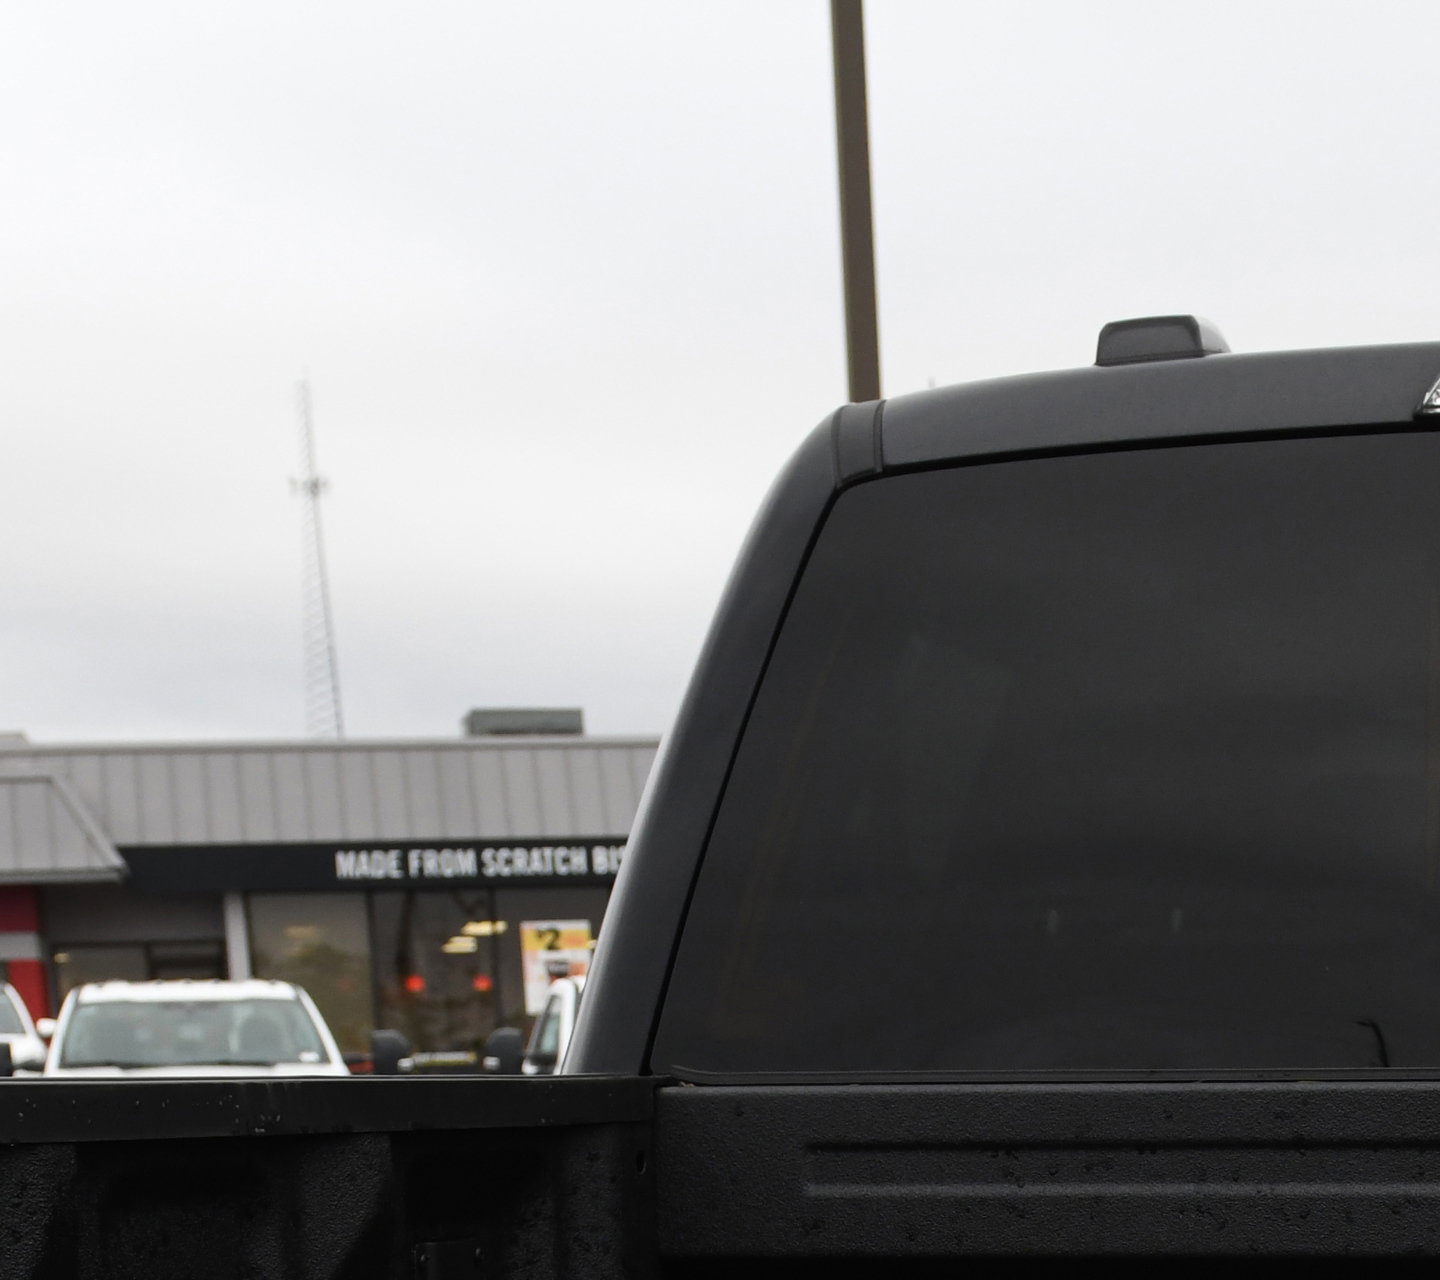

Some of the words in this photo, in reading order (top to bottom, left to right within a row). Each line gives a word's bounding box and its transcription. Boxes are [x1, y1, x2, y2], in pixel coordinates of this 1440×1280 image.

[335, 849, 403, 879] MADE
[408, 847, 477, 878] FROM
[481, 846, 588, 877] SCRATCH
